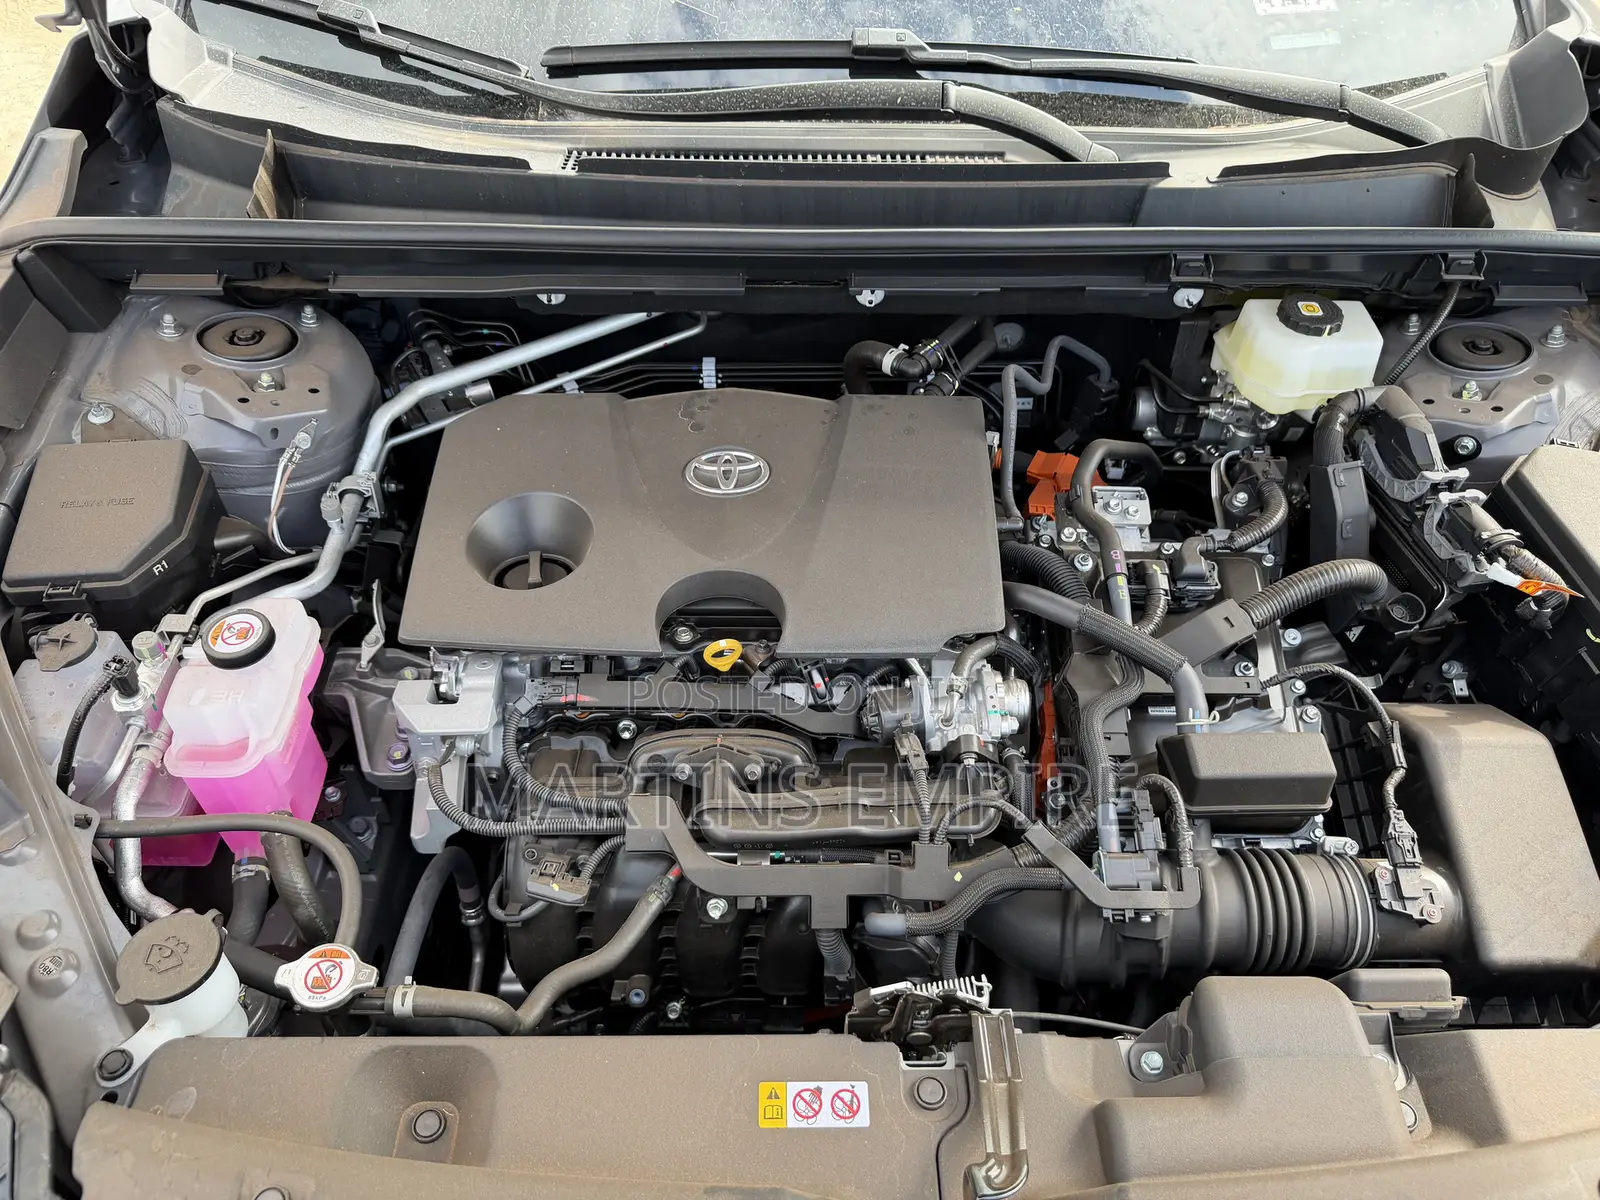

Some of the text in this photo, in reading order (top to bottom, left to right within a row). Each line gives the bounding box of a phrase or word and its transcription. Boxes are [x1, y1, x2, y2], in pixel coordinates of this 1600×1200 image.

[60, 498, 95, 509] RELAY
[106, 497, 135, 507] FUSE
[152, 559, 169, 576] R1
